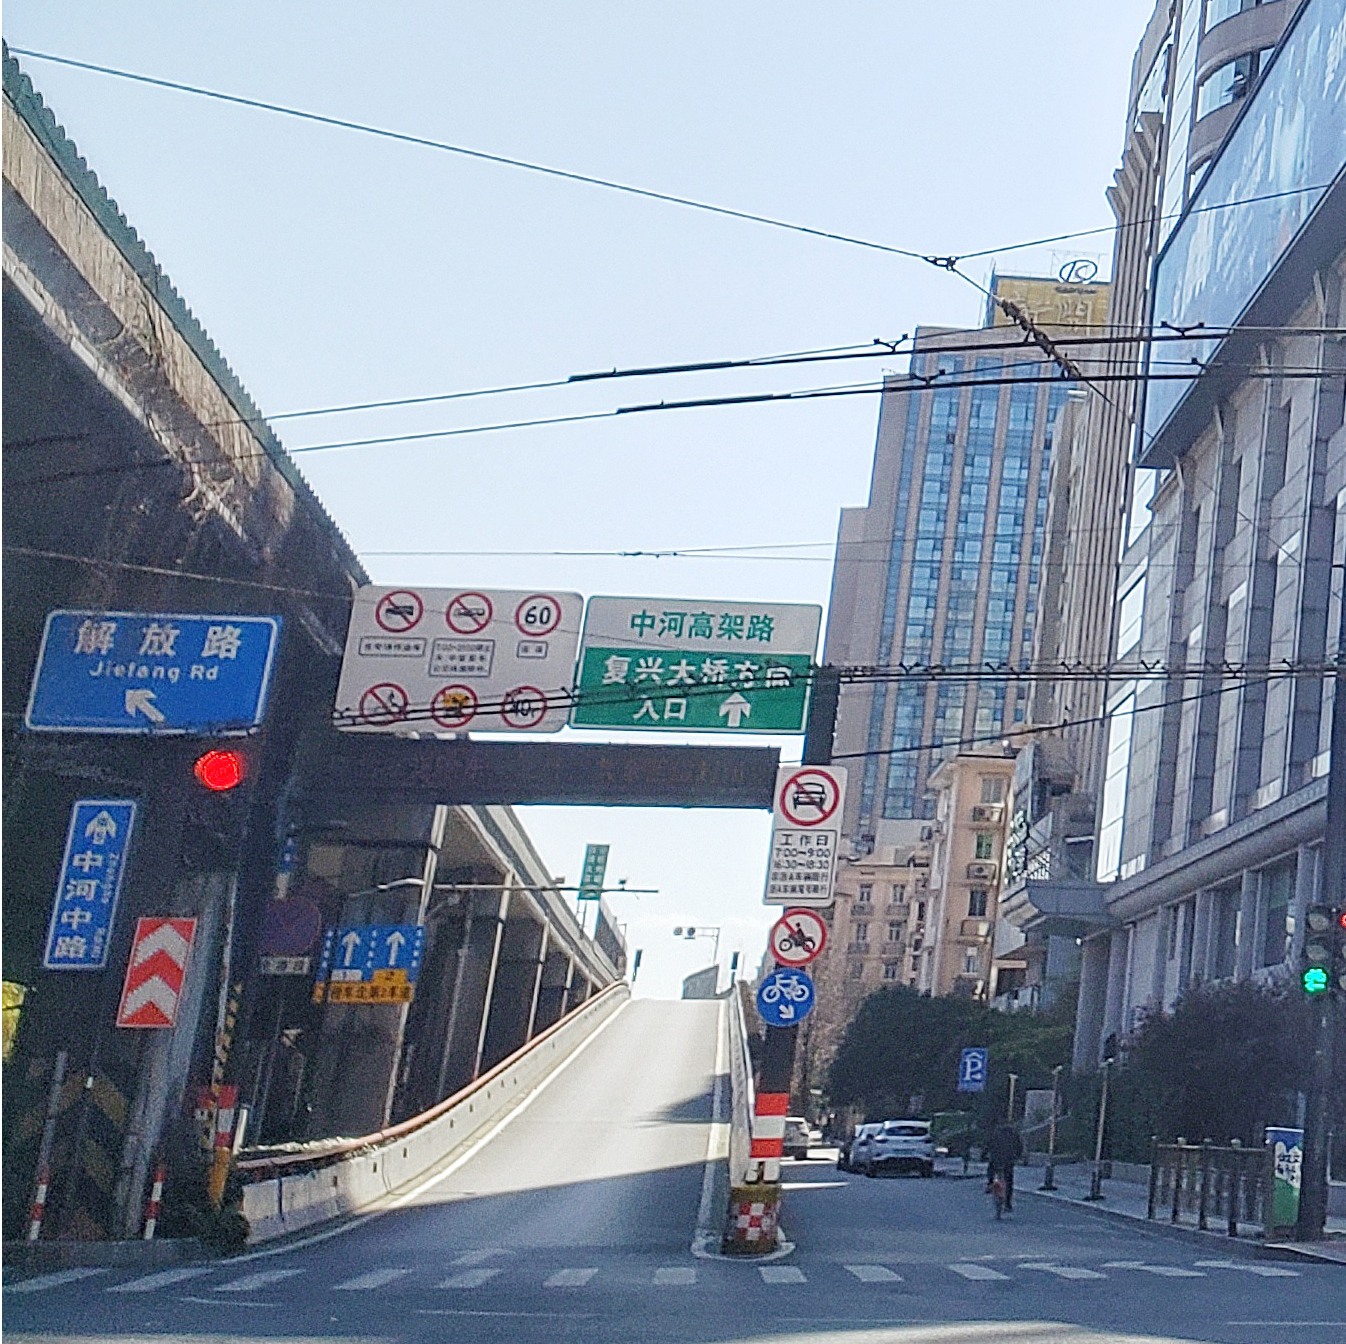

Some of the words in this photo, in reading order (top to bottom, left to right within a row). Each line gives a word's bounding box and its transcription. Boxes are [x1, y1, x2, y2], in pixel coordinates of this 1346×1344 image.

[524, 605, 551, 625] 60
[630, 609, 775, 643] 中河高架路
[74, 619, 242, 660] 解放路
[89, 660, 180, 683] Jiefang
[189, 664, 219, 681] Rd
[602, 654, 794, 688] 复兴大桥方向
[632, 694, 687, 721] 入口
[780, 833, 829, 846] 工作日
[55, 851, 102, 958] 中河中路
